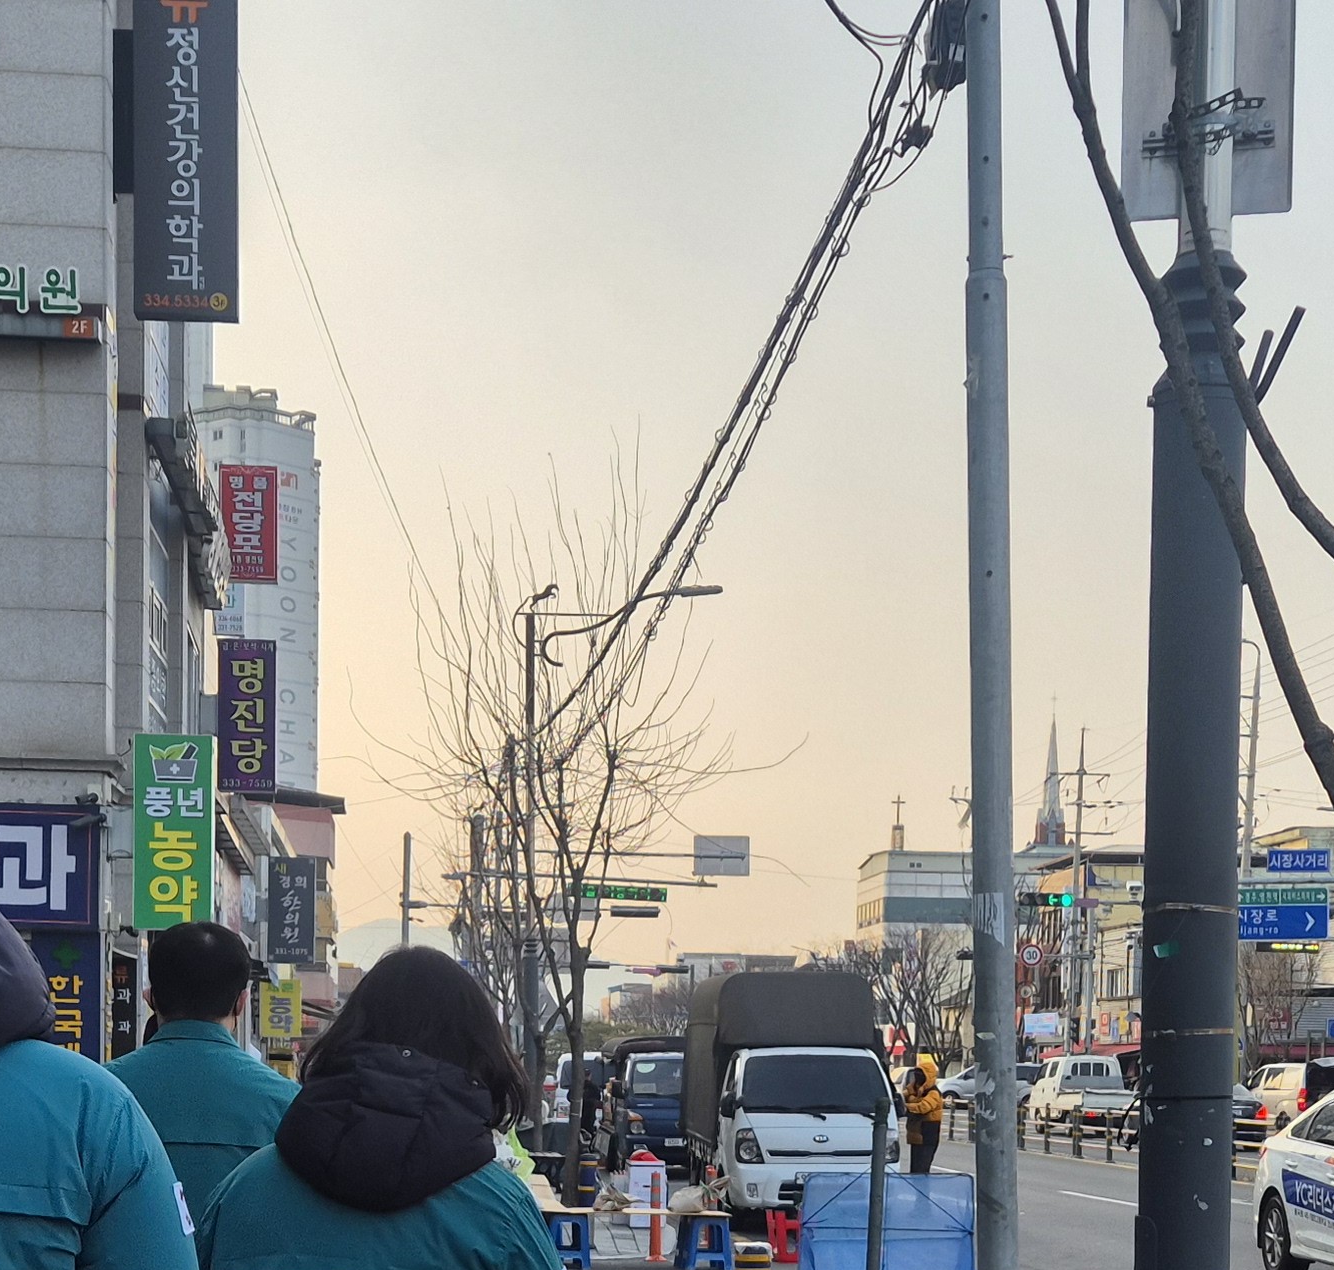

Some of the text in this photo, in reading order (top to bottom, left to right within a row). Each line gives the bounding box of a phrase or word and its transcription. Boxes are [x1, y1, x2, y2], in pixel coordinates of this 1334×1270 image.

[166, 27, 204, 290] 정신건강의학과
[70, 319, 89, 335] 2F
[232, 491, 264, 553] 전당포
[230, 657, 267, 775] 명진당
[222, 778, 273, 788] 333-7559
[143, 786, 205, 819] 풍년
[1269, 853, 1328, 868] 시장사거리
[148, 823, 198, 922] 농약
[279, 875, 307, 888] 경희
[1240, 925, 1278, 936] ijang-ro
[1026, 950, 1038, 961] 30
